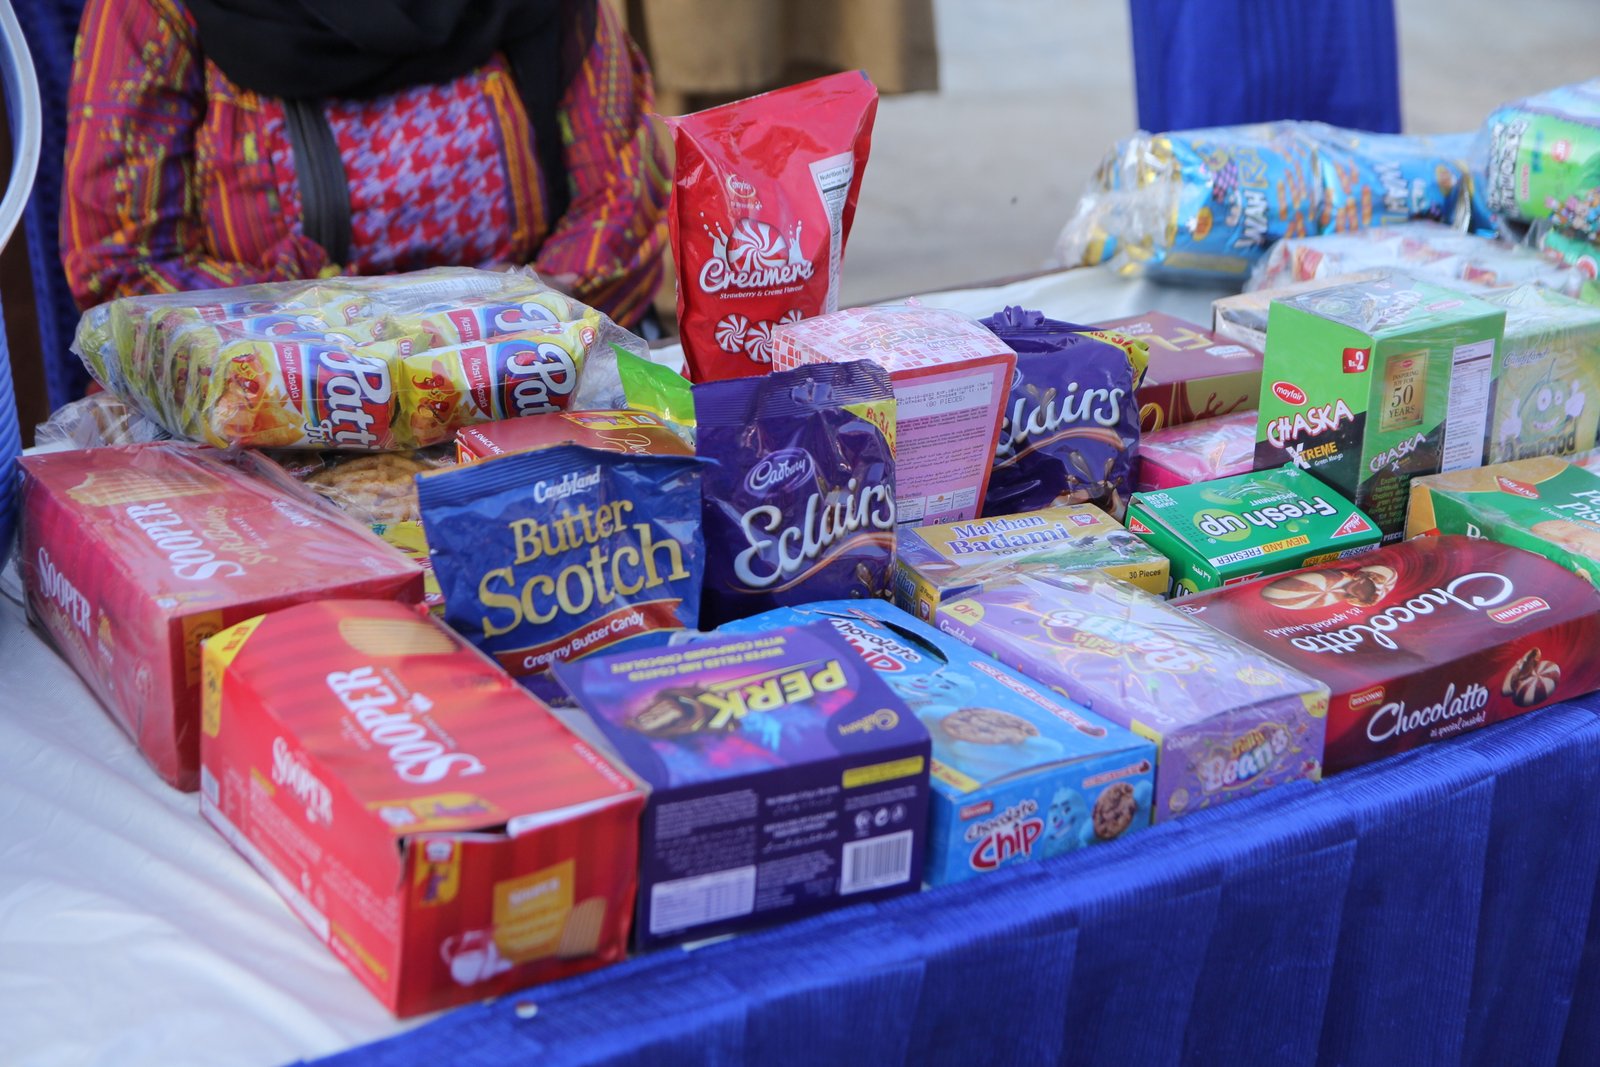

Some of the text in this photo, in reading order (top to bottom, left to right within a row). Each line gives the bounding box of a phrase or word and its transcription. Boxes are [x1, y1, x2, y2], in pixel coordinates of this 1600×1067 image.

[699, 258, 815, 294] Creamers
[719, 290, 757, 300] Strawberry
[506, 342, 578, 416] Pat
[1276, 385, 1303, 402] mayfair
[1391, 384, 1414, 408] 50
[1267, 398, 1355, 448] CHASKA
[1389, 405, 1416, 418] YEARS
[1369, 432, 1427, 473] CHASKA
[749, 456, 808, 491] Cadbury
[953, 512, 1047, 541] Makhan
[1243, 495, 1339, 530] Fresh
[126, 501, 247, 581] SOOPER
[508, 499, 634, 565] Butter
[734, 477, 896, 588] Eclairs
[946, 523, 1071, 555] Badami
[1216, 535, 1308, 565] NEW AND FRESHER
[1303, 544, 1375, 567] NEW AND FRESHER
[478, 524, 690, 639] Scotch
[1129, 568, 1162, 579] 30 Pieces
[38, 546, 93, 638] SOOPER
[1292, 572, 1513, 654] Chocolatto
[1493, 600, 1543, 622] BISCONNI
[523, 611, 644, 669] Creamy Butter Candy
[611, 635, 785, 673] WITH COMPOUND CHOCOLATE
[628, 665, 676, 682] COATED
[677, 661, 702, 674] AND
[703, 654, 742, 669] FILLED
[698, 659, 848, 730] PERK
[1366, 682, 1489, 742] Chocolatto
[327, 665, 486, 784] SOOPER
